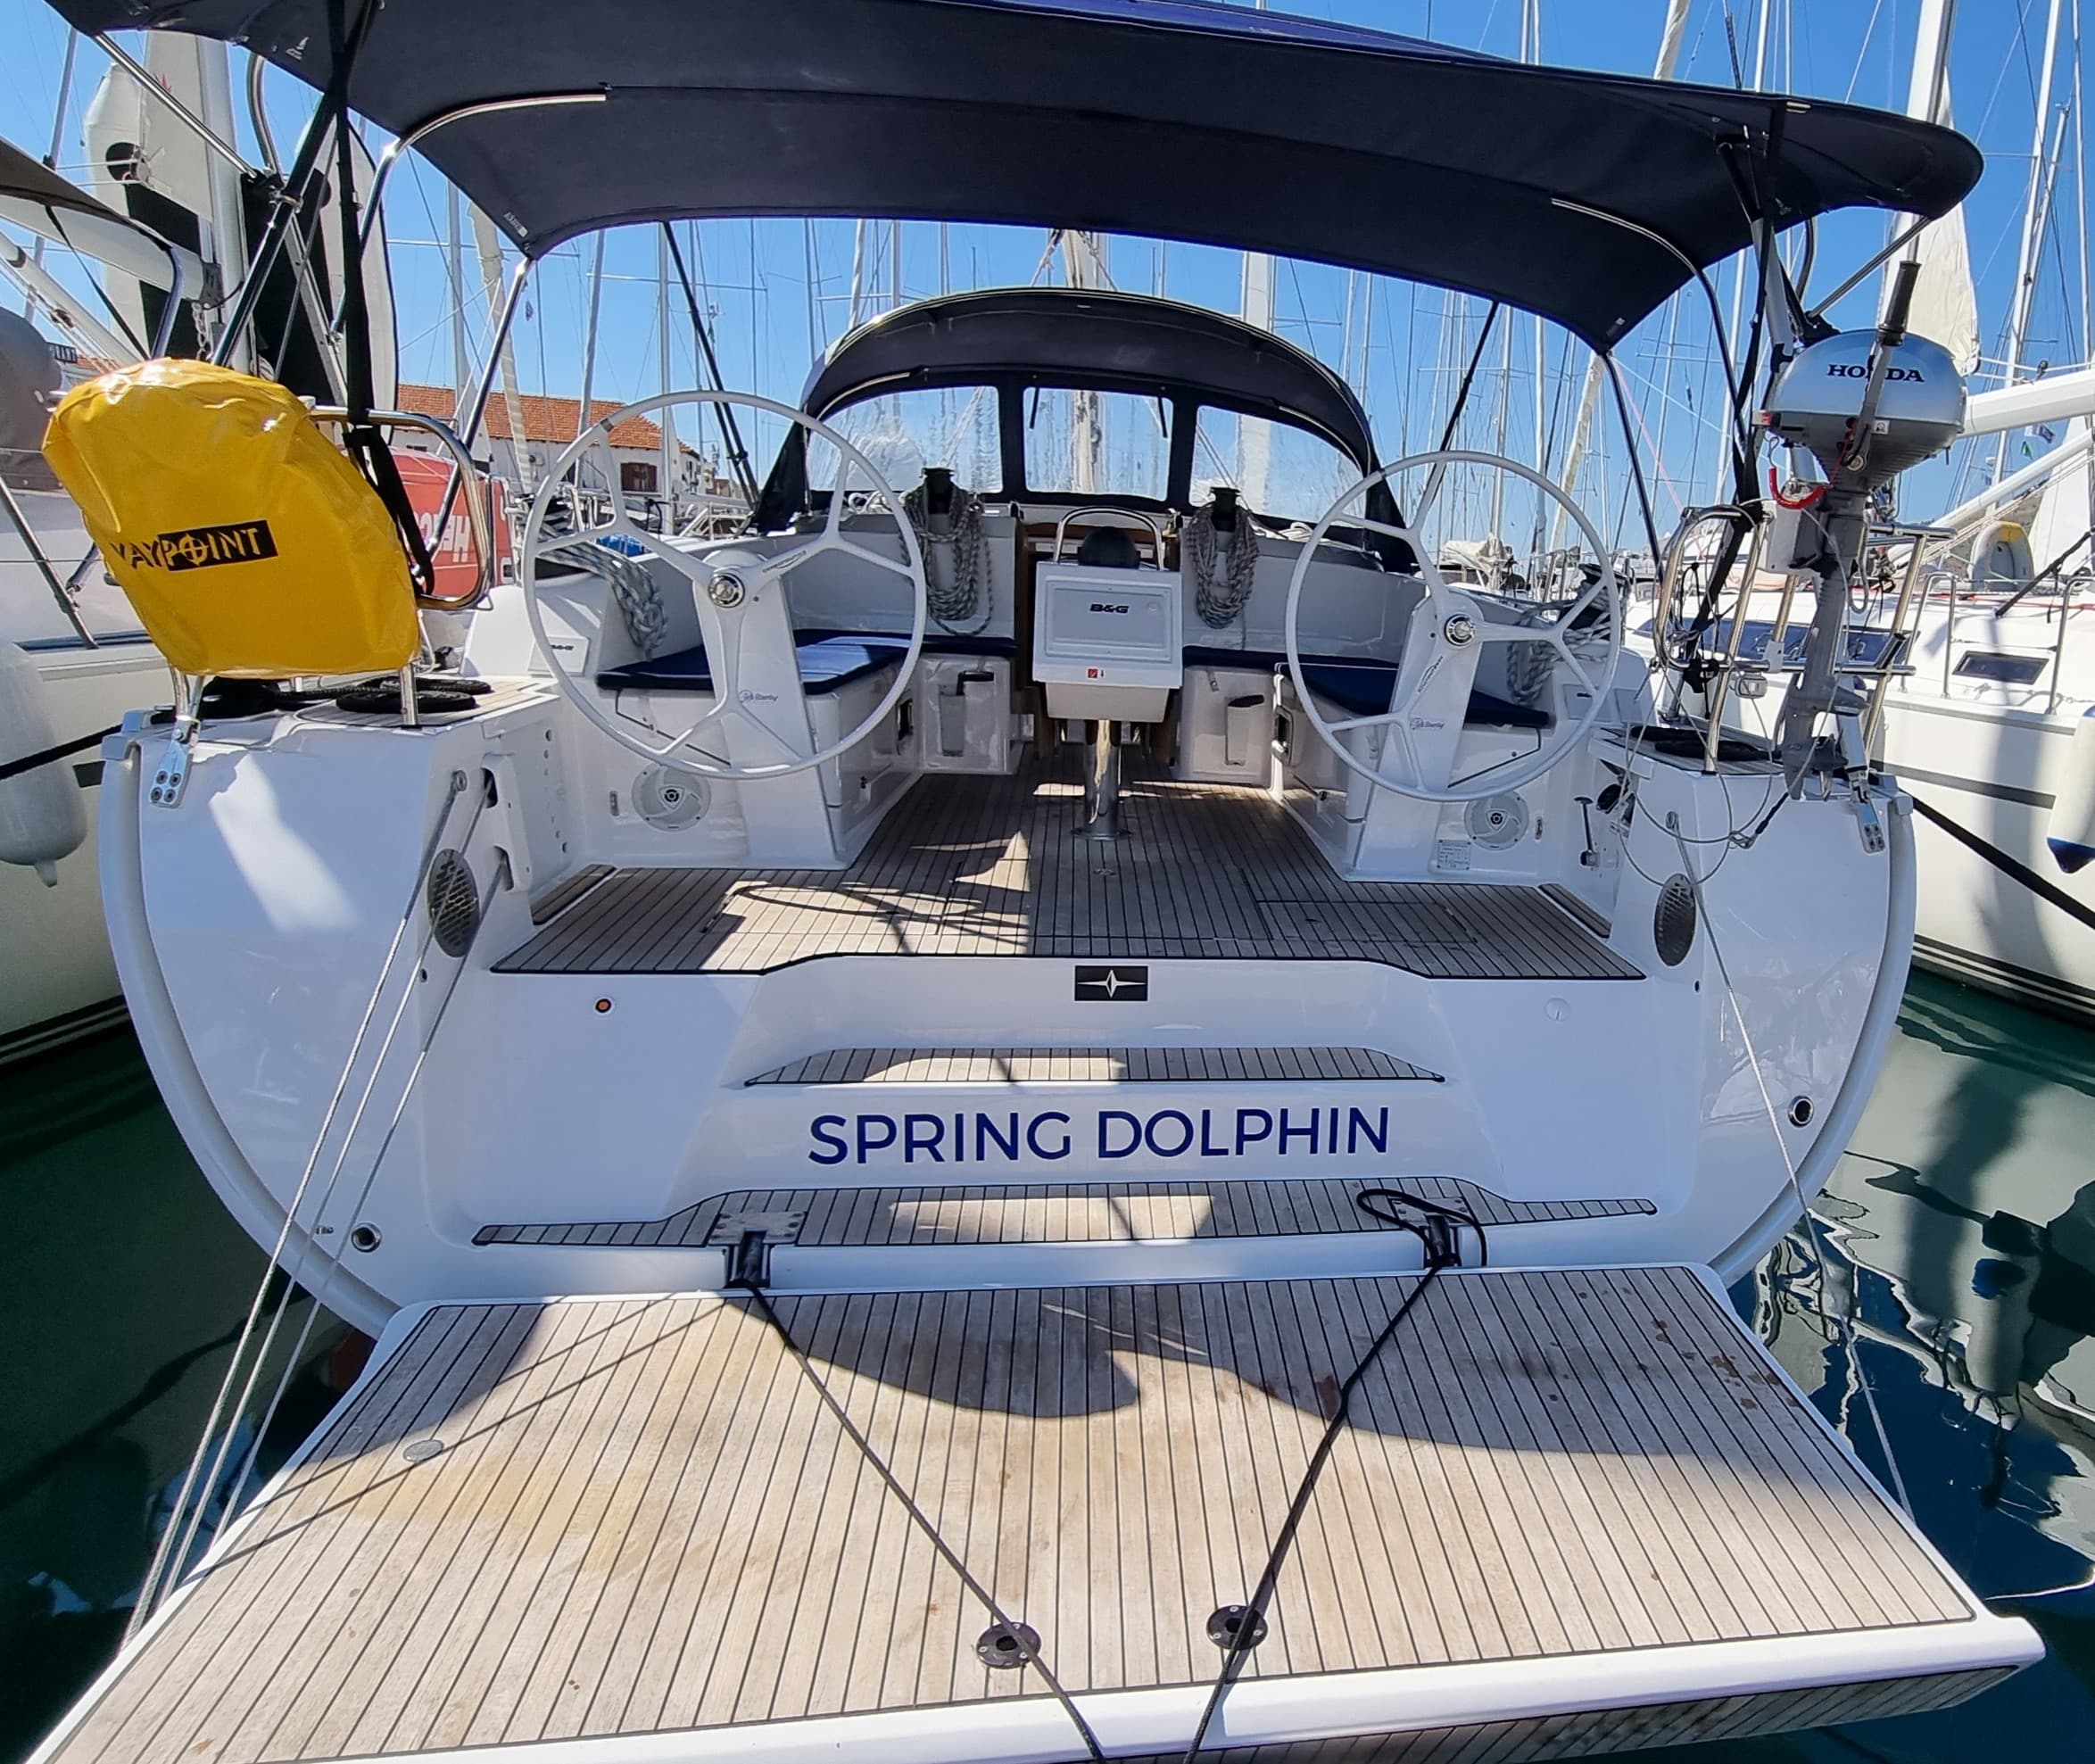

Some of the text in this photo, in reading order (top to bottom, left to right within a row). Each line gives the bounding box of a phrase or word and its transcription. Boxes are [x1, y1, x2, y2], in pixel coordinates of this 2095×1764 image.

[1089, 603, 1130, 614] B&G
[808, 1106, 1388, 1165] SPRING DOLPHIN
